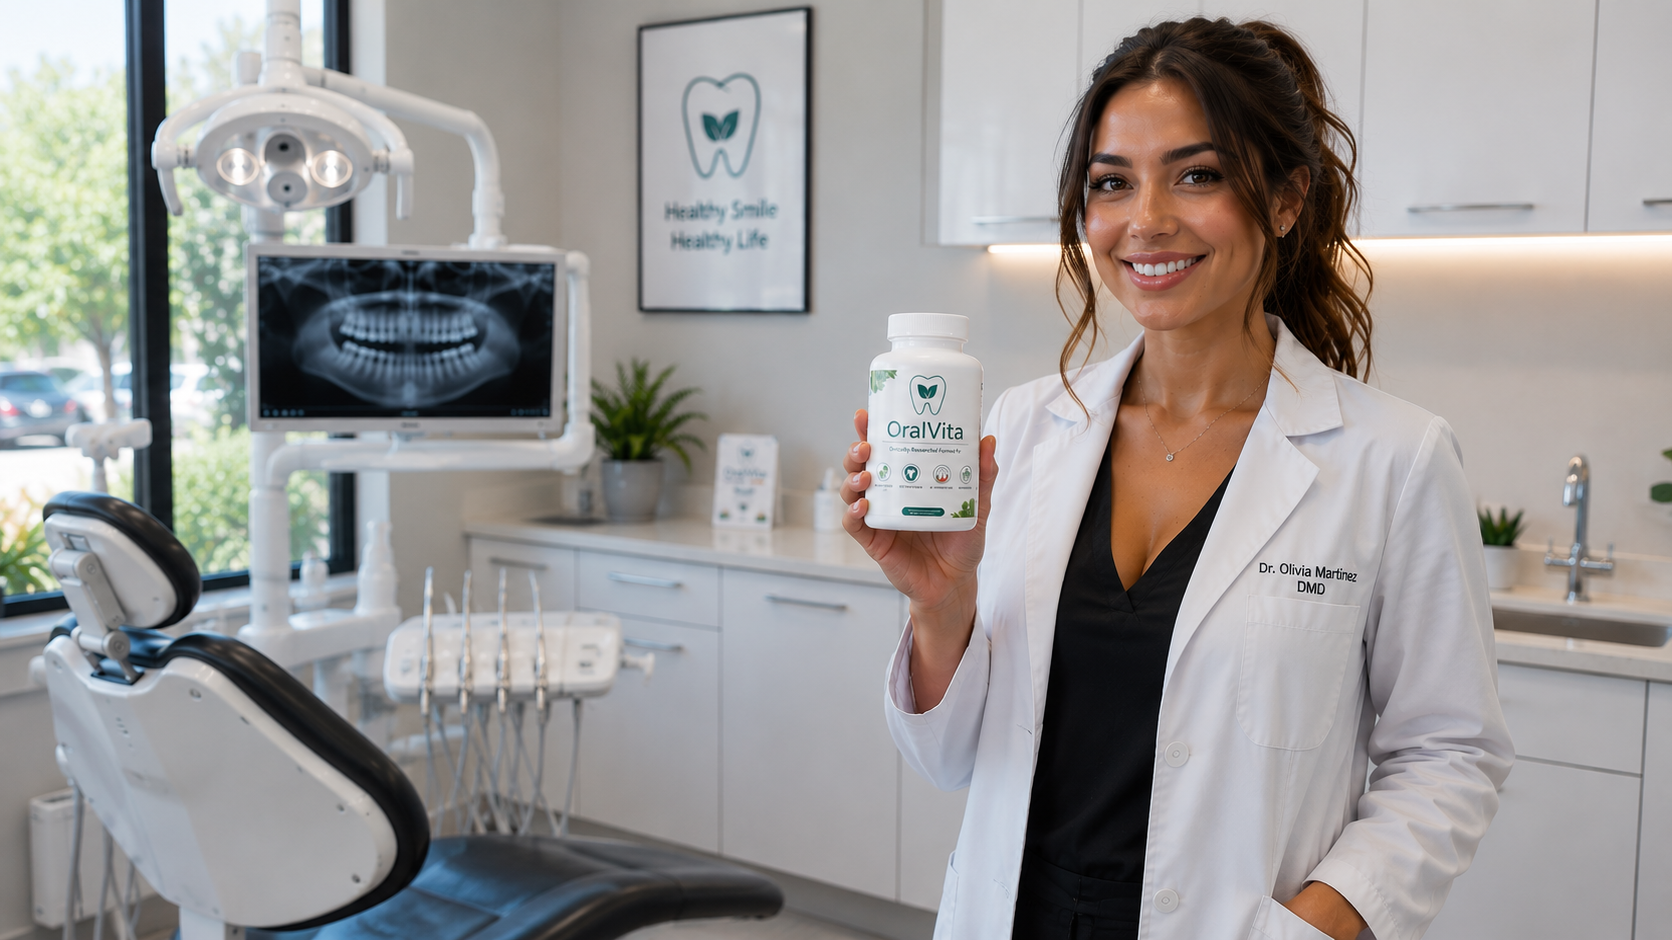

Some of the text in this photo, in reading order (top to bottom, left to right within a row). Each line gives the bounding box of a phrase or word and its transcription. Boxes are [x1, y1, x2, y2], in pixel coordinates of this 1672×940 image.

[664, 199, 779, 225] Healthy Smile
[670, 229, 769, 255] Healthy Life
[887, 420, 964, 440] OralVita
[1259, 562, 1358, 582] Dr. Olivia Martinez
[1297, 580, 1326, 595] DMD
